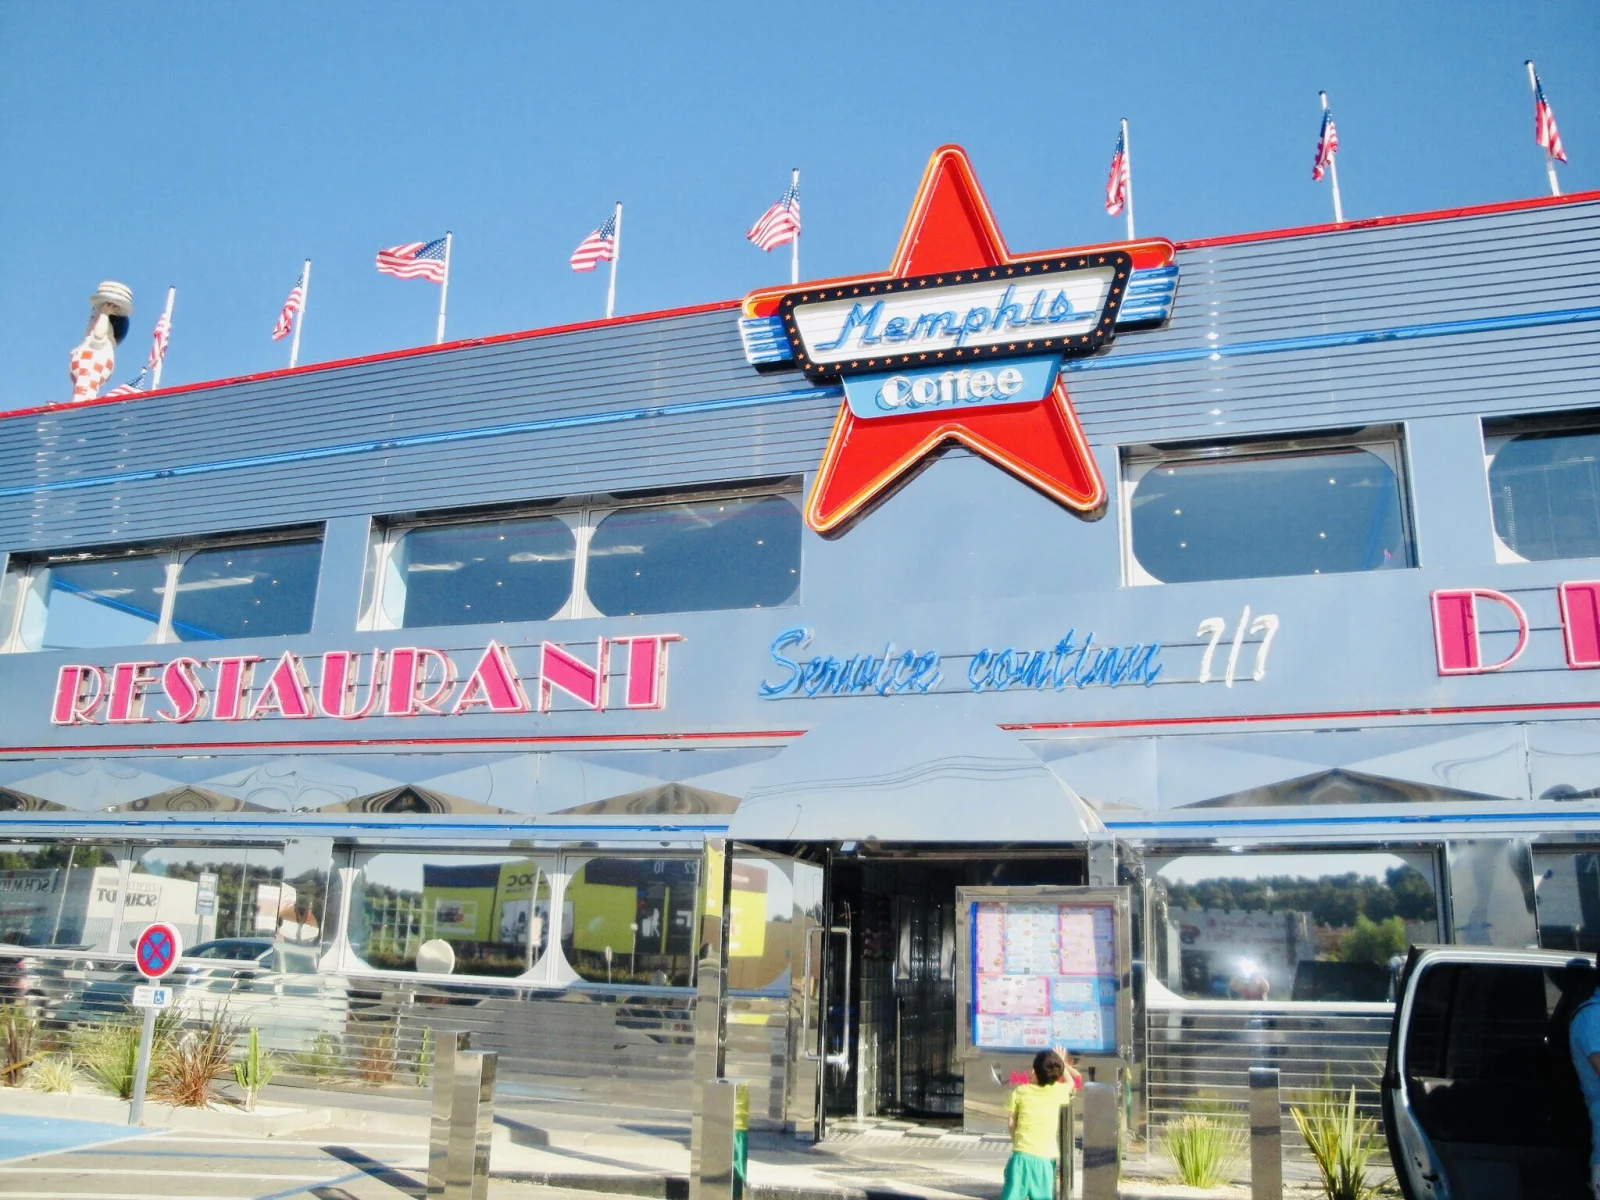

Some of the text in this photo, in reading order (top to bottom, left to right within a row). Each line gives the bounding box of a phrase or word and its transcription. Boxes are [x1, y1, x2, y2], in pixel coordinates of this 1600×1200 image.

[813, 282, 1097, 351] Memphis
[878, 367, 1024, 410] Coffee
[51, 632, 687, 725] RESTAURANT
[758, 604, 1279, 699] Service continu 7/7
